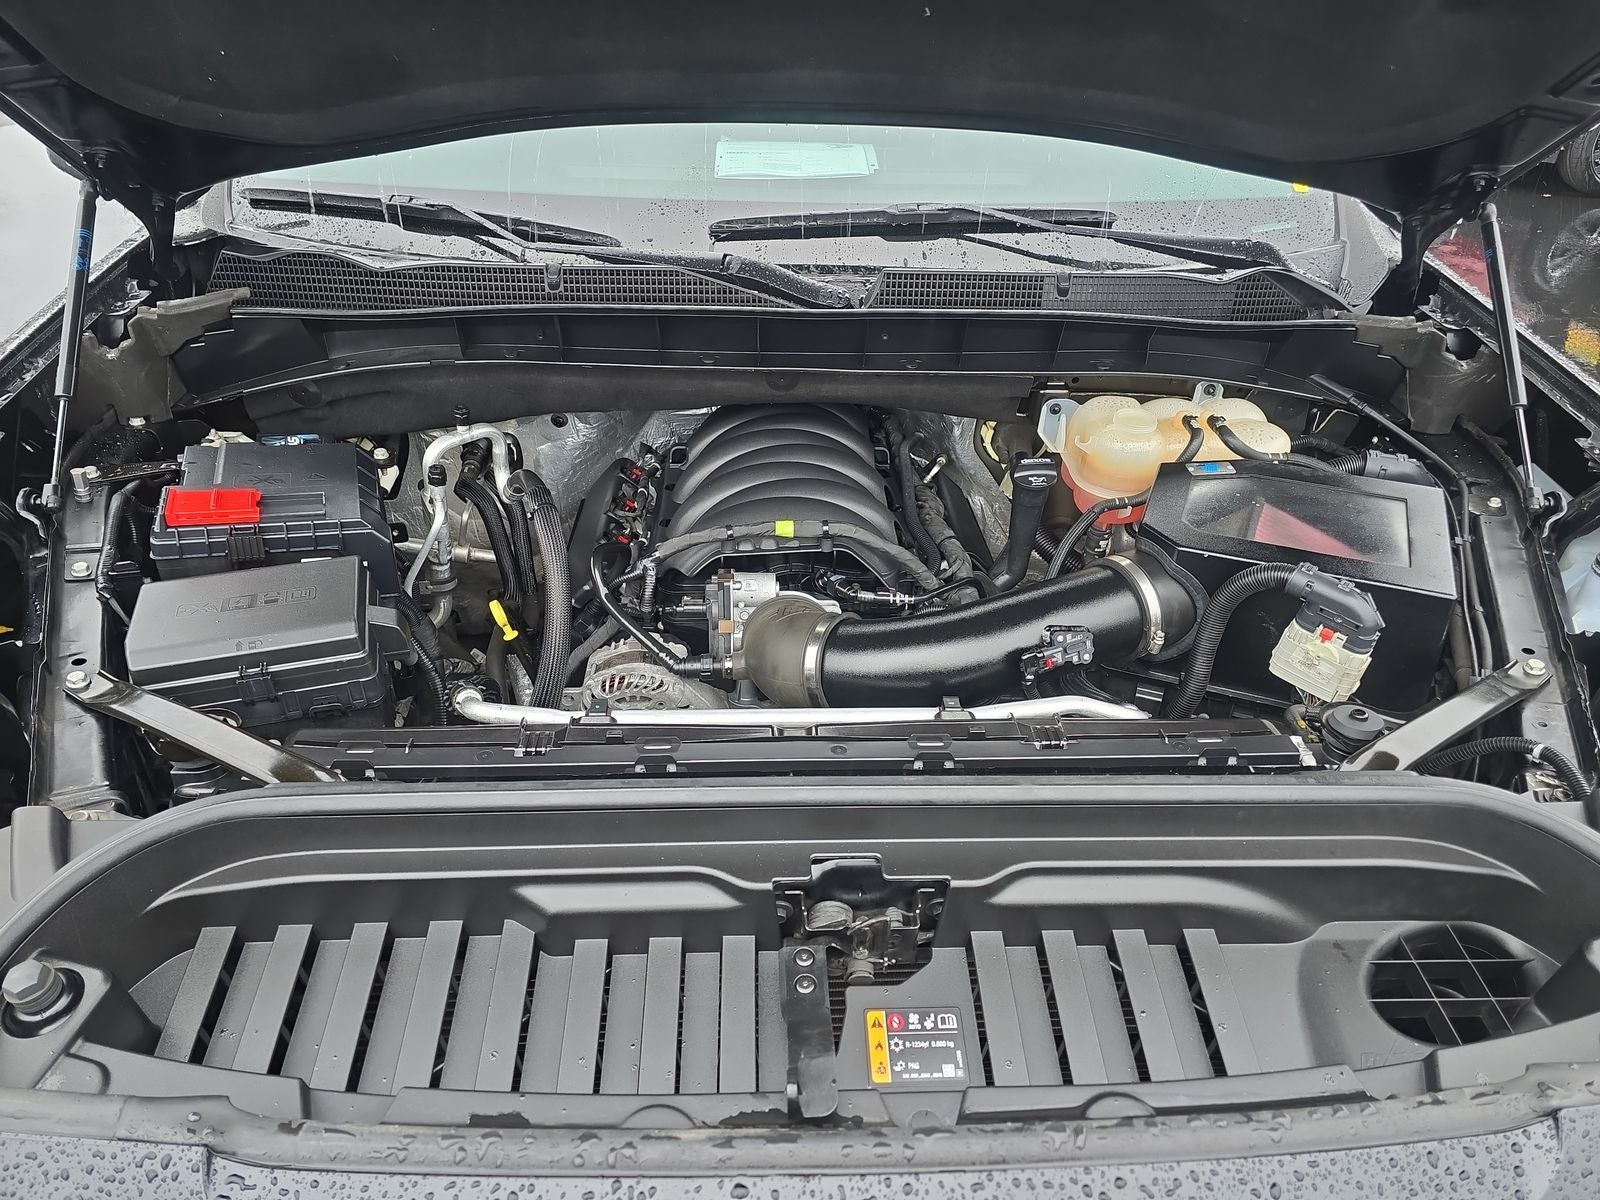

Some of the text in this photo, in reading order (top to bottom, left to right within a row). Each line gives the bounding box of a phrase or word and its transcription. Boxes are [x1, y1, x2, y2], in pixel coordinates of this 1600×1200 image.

[905, 1040, 929, 1048] R-1234yf
[947, 1040, 955, 1048] kg
[907, 1062, 920, 1070] PAG
